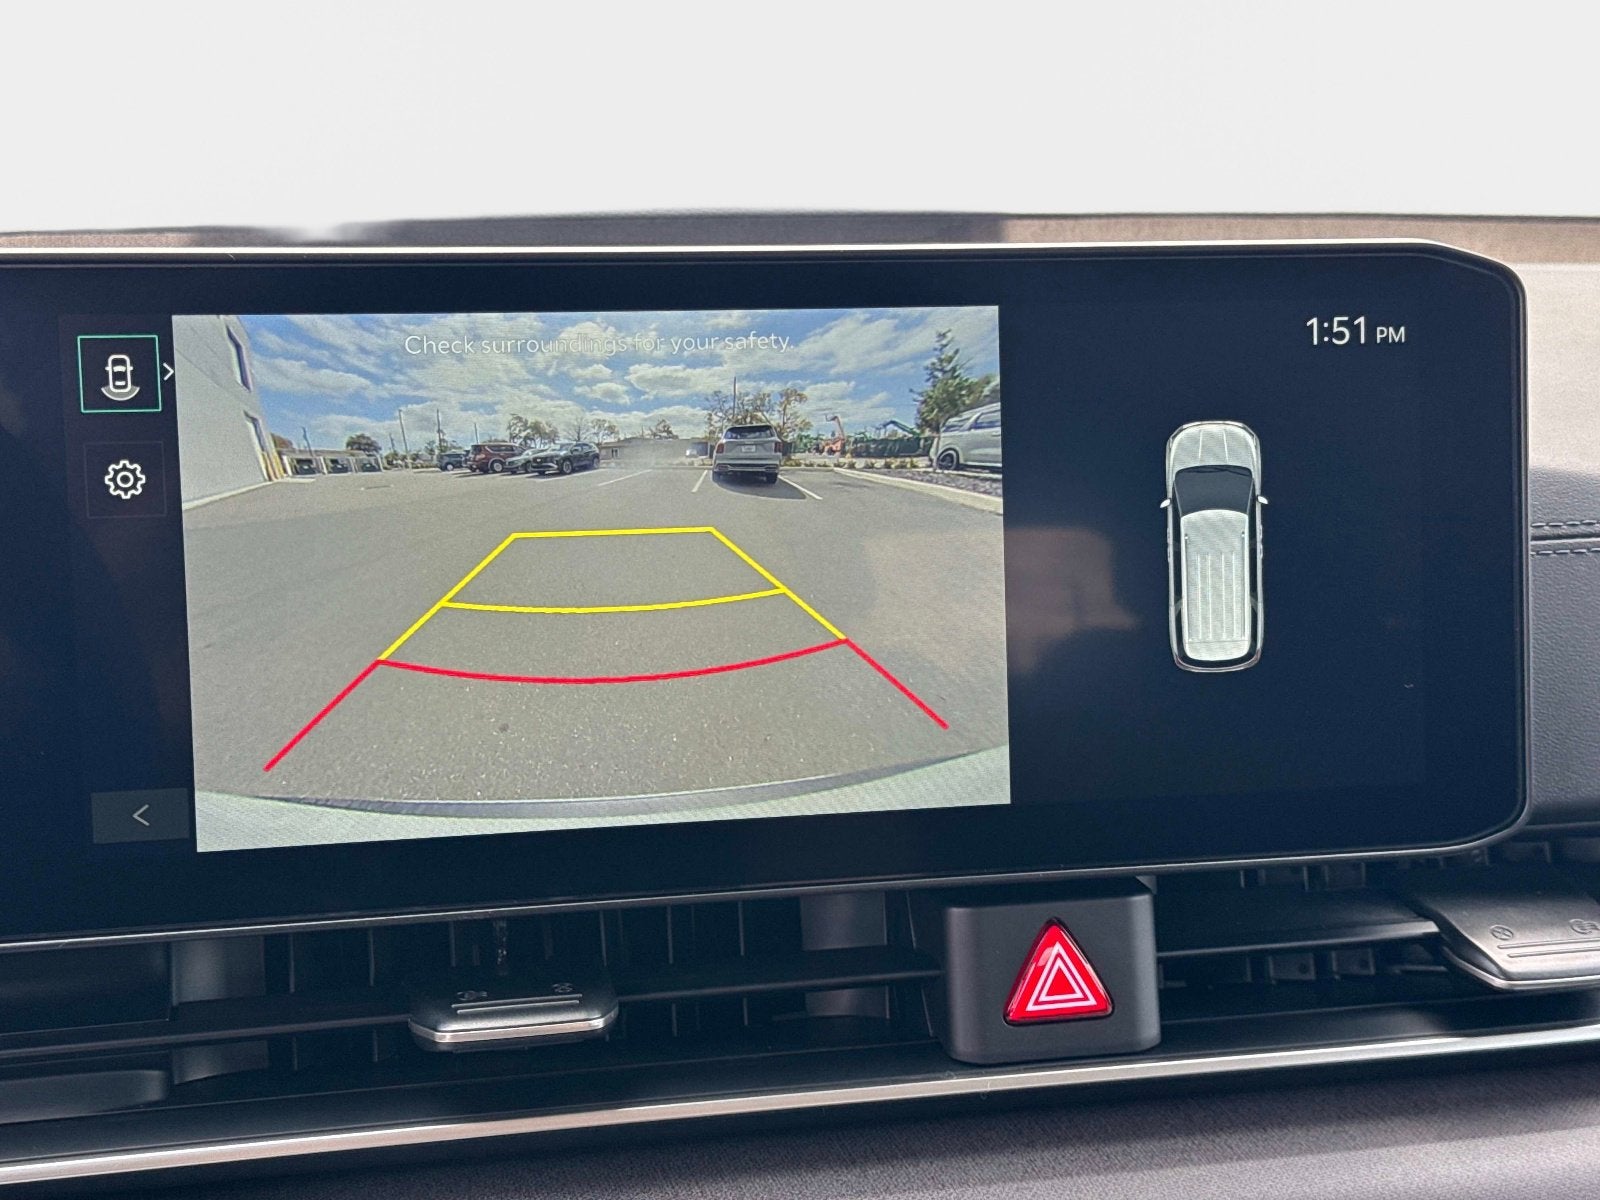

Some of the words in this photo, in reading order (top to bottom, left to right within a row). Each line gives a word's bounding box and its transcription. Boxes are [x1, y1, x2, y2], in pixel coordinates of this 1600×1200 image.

[405, 335, 475, 355] Check
[481, 332, 627, 356] surroundings
[635, 332, 665, 352] for
[670, 336, 719, 355] your
[724, 331, 794, 352] safety.
[1306, 316, 1365, 345] 1:51
[1376, 326, 1406, 344] PM
